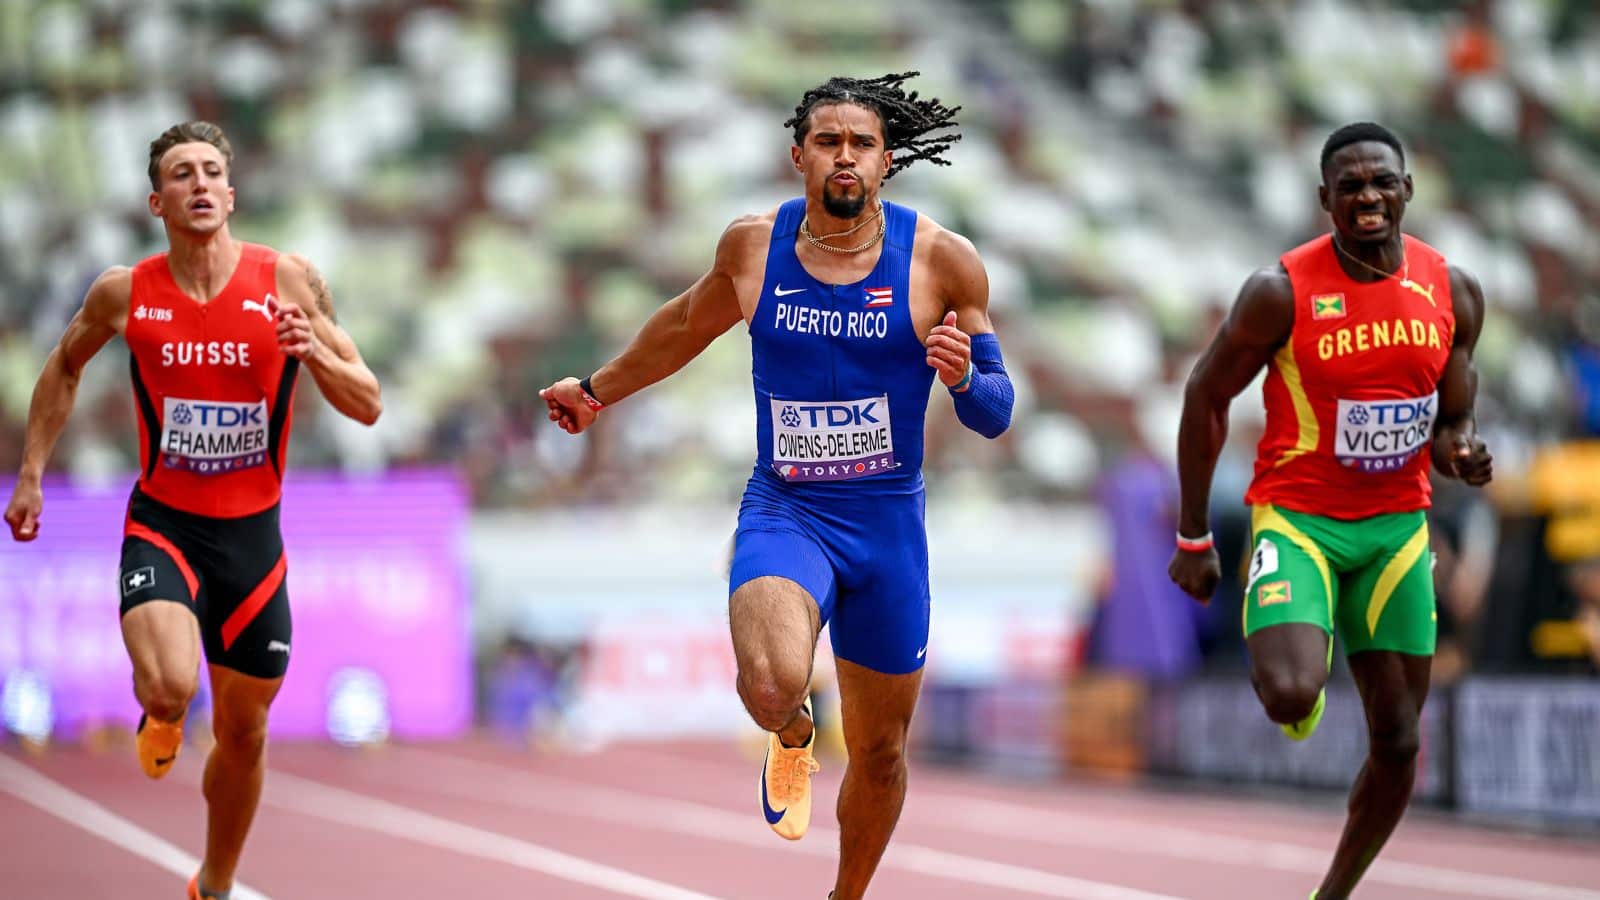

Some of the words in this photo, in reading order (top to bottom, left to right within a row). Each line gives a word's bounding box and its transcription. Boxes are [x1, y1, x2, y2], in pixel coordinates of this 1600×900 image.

[148, 308, 173, 321] UBS
[775, 302, 842, 336] PUERTO
[847, 311, 888, 338] RICO
[1318, 319, 1441, 361] GRENADA
[193, 405, 263, 427] TDK
[800, 401, 880, 428] TDK
[1370, 398, 1433, 425] TDK
[167, 428, 265, 455] EHAMMER
[778, 427, 888, 458] OWENS-DELERME
[1344, 420, 1429, 453] VICTOR
